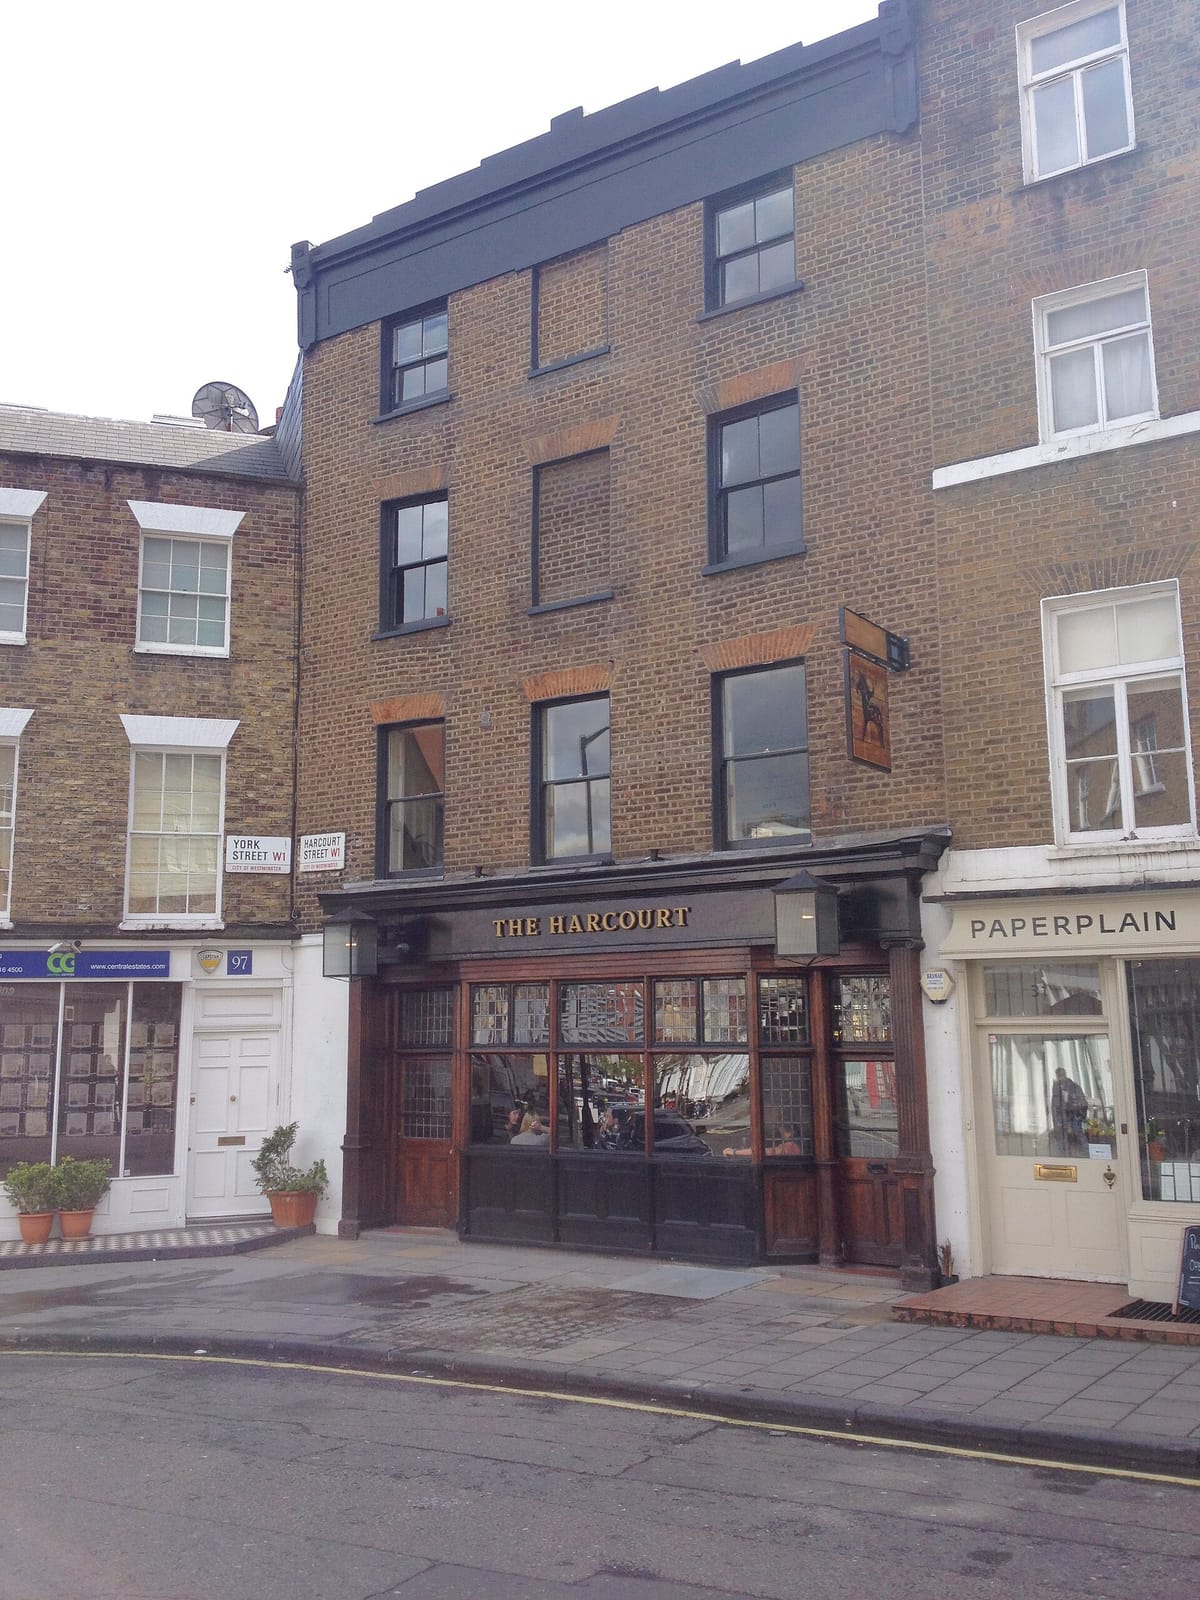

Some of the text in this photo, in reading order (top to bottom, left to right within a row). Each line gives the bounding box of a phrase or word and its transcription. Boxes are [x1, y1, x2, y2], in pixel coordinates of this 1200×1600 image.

[233, 839, 260, 849] YORK
[304, 836, 341, 848] HARCOURT
[232, 851, 286, 861] STREET W1
[303, 848, 341, 860] STREET W1
[492, 907, 690, 937] THE HARCOURT
[970, 910, 1177, 939] PAPERPLAIN
[232, 956, 248, 970] 97
